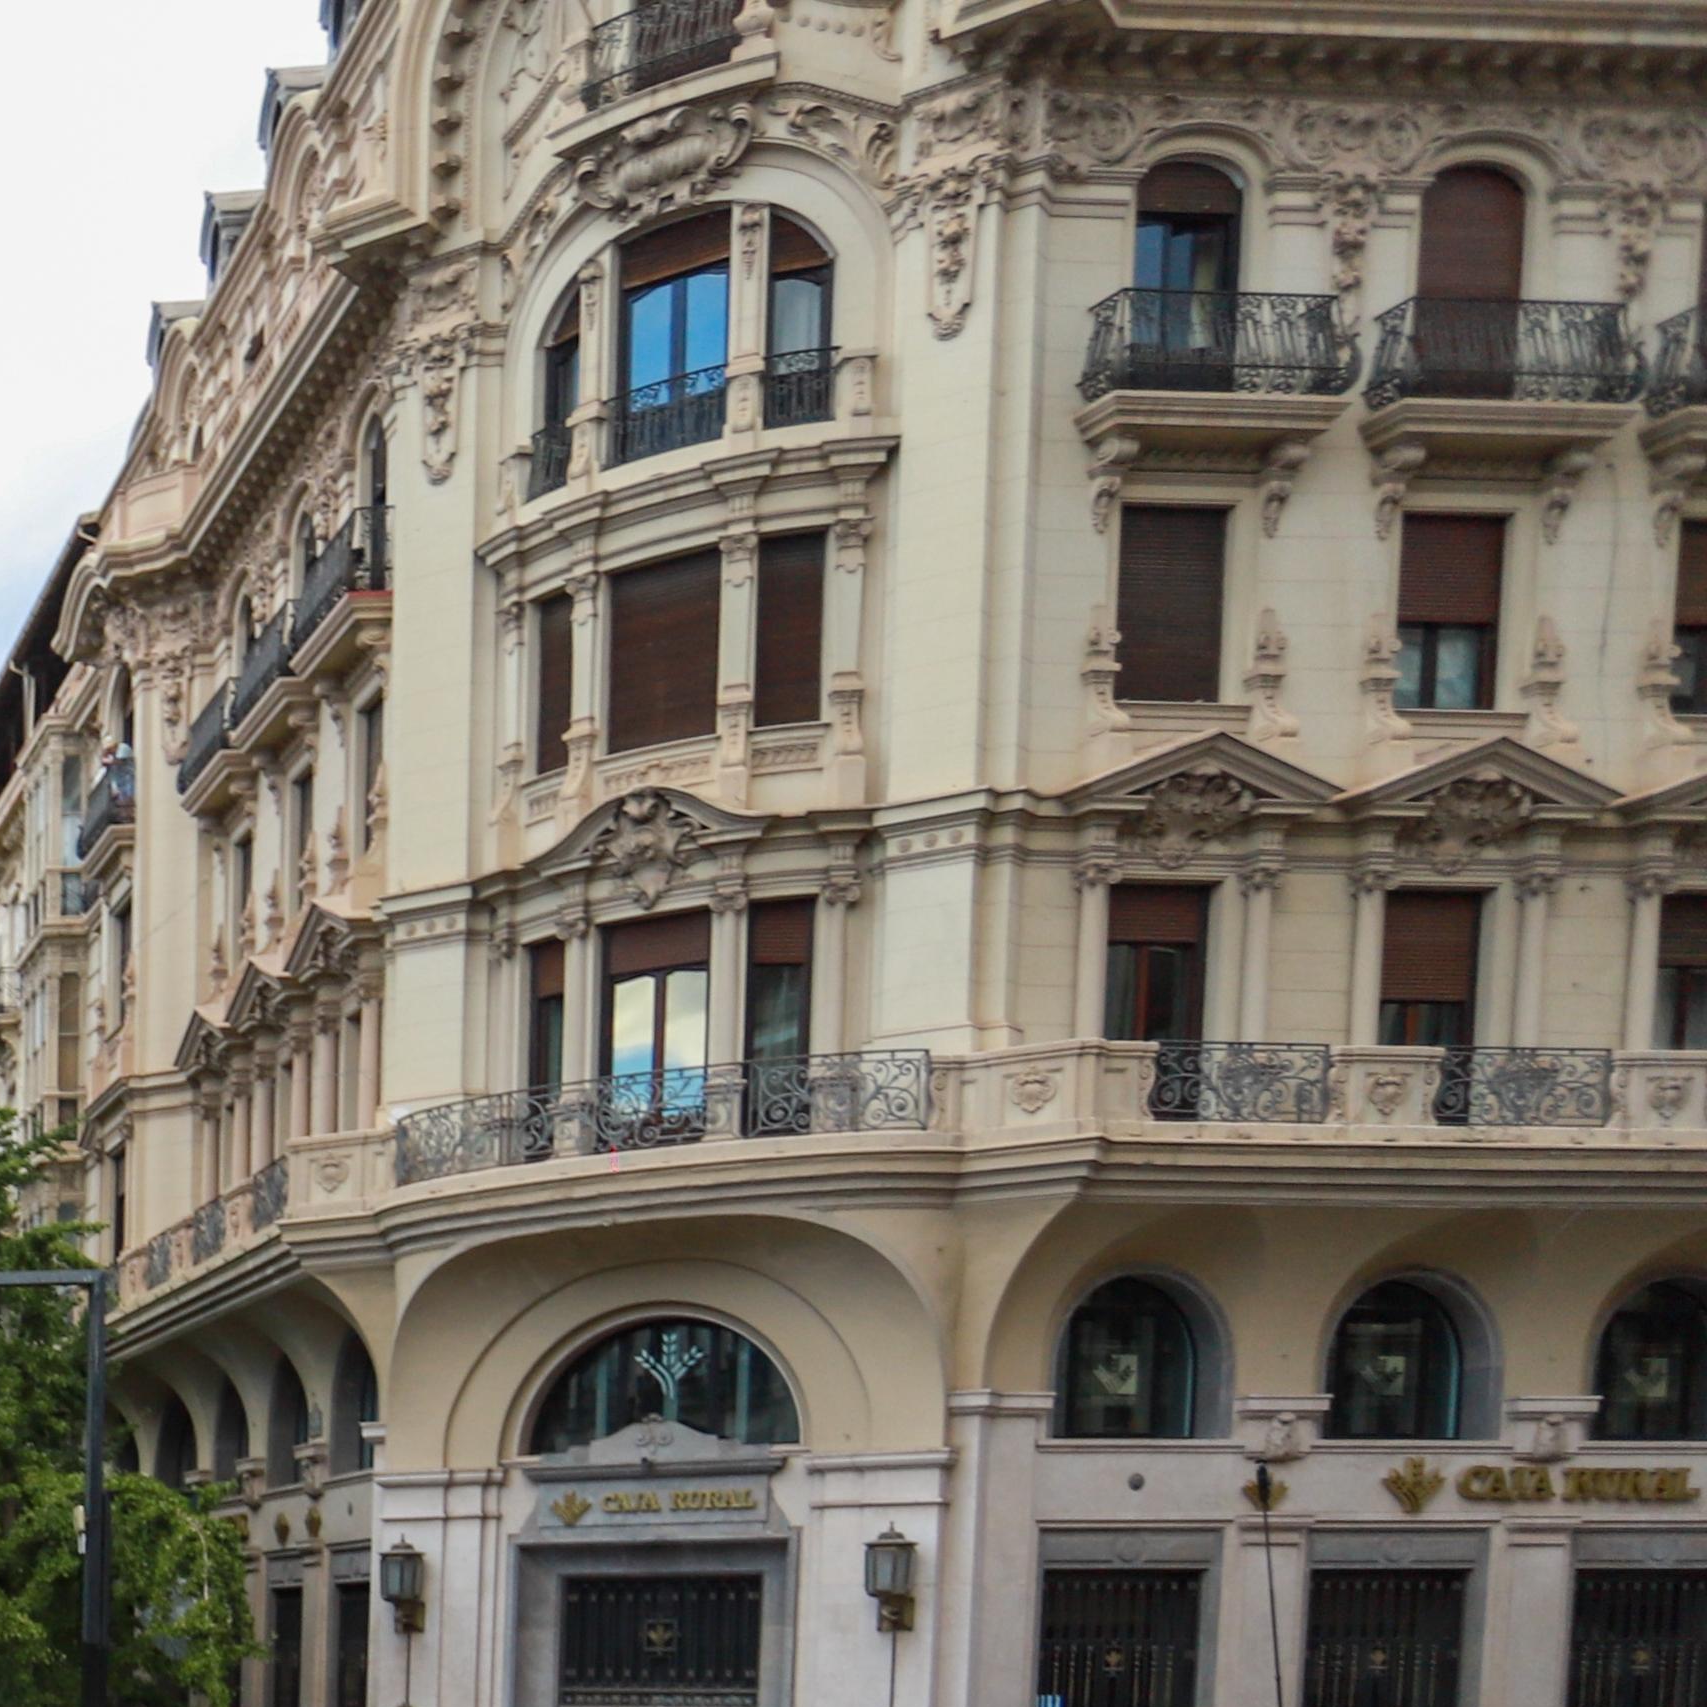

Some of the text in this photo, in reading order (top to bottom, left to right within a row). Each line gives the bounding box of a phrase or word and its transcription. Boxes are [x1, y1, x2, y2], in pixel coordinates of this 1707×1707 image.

[1455, 1465, 1701, 1501] CAJA RURAL
[601, 1488, 757, 1514] CAJA RURAL
